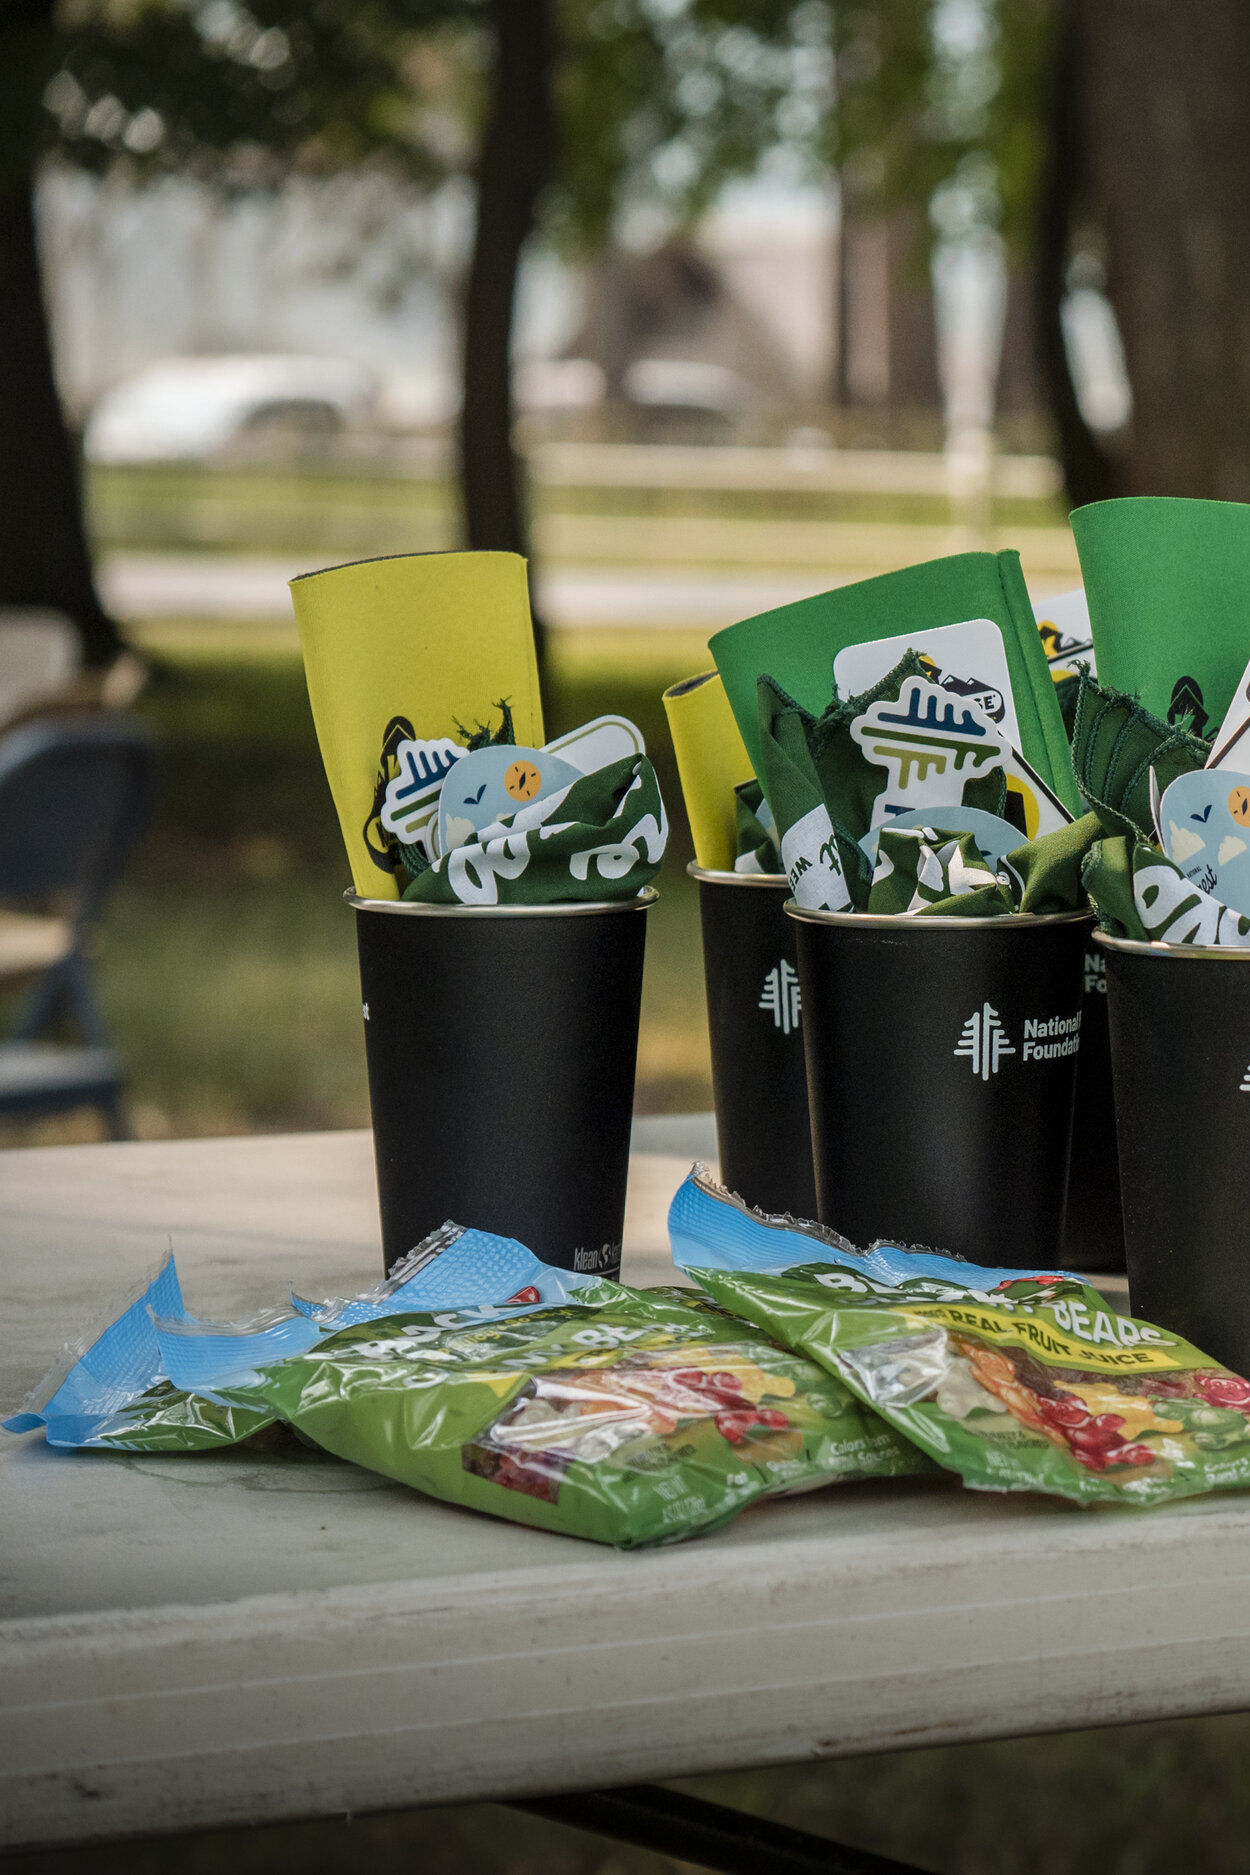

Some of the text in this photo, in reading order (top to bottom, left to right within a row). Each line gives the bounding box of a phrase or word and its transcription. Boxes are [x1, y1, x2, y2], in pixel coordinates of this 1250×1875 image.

[574, 1247, 599, 1271] klean
[946, 1308, 1009, 1334] REAL
[1011, 1321, 1071, 1357] FRUIT
[1078, 1350, 1155, 1365] JUICE
[1050, 1300, 1178, 1348] BEARS
